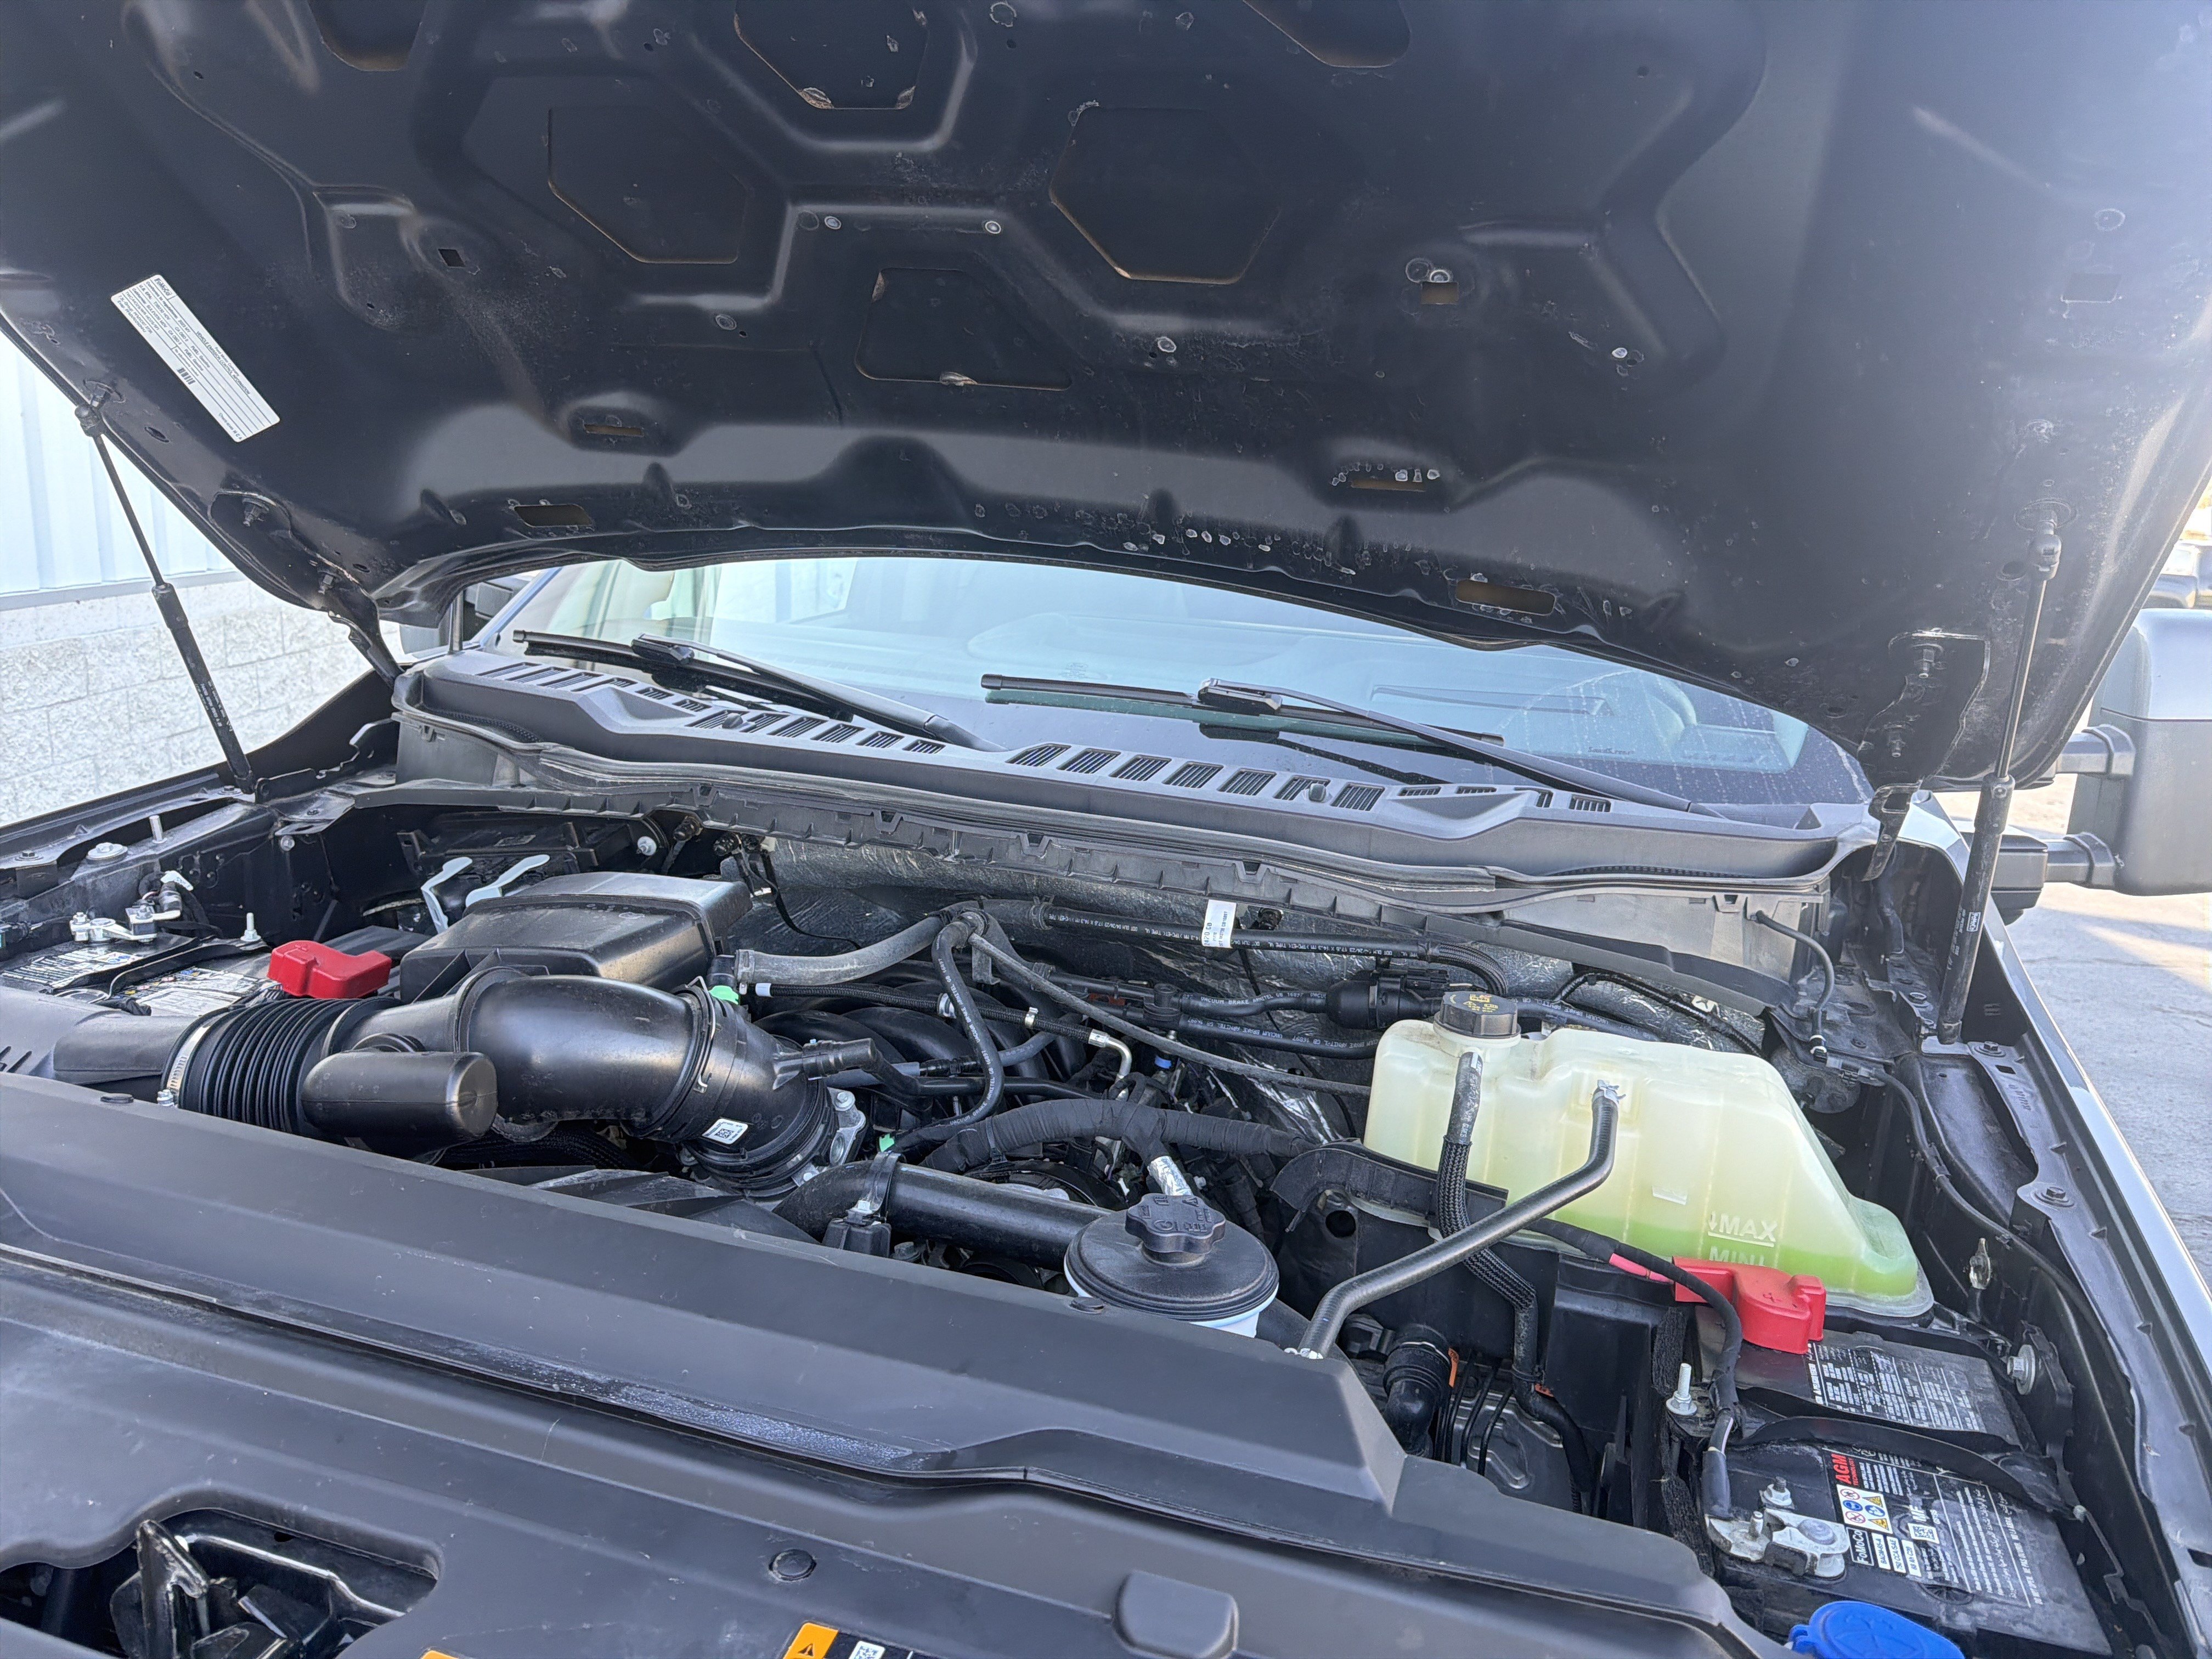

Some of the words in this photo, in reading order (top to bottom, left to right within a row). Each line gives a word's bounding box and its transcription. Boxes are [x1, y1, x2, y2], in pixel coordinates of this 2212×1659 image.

[191, 358, 204, 371] Gasoline
[195, 331, 208, 345] VEHICLE
[206, 344, 221, 360] EMISSION
[219, 359, 233, 374] CONTROL
[232, 374, 250, 395] INFORMATION
[198, 355, 211, 368] Gasoline
[938, 958, 947, 974] 16897
[1200, 996, 1224, 1005] VACUUM
[961, 1006, 972, 1023] BRAKE
[1564, 1007, 1583, 1017] BRAKE
[1585, 1013, 1609, 1025] VACUUM
[969, 1024, 981, 1043] VACUUM
[1242, 1027, 1260, 1035] BRAKE
[1262, 1030, 1283, 1039] VACUUM
[950, 1115, 972, 1126] VACUUM
[972, 1101, 988, 1118] BRAKE
[986, 1076, 996, 1099] ARNITEL
[1719, 1212, 1778, 1243] MAX
[1831, 1453, 1852, 1485] AGM
[1848, 1457, 1859, 1486] TECHNOLOGY
[1859, 1462, 1867, 1480] SPILLABLE
[1909, 1504, 1927, 1522] MF
[1853, 1530, 1869, 1564] FoMoCo
[1889, 1539, 1900, 1561] CCA/SAE
